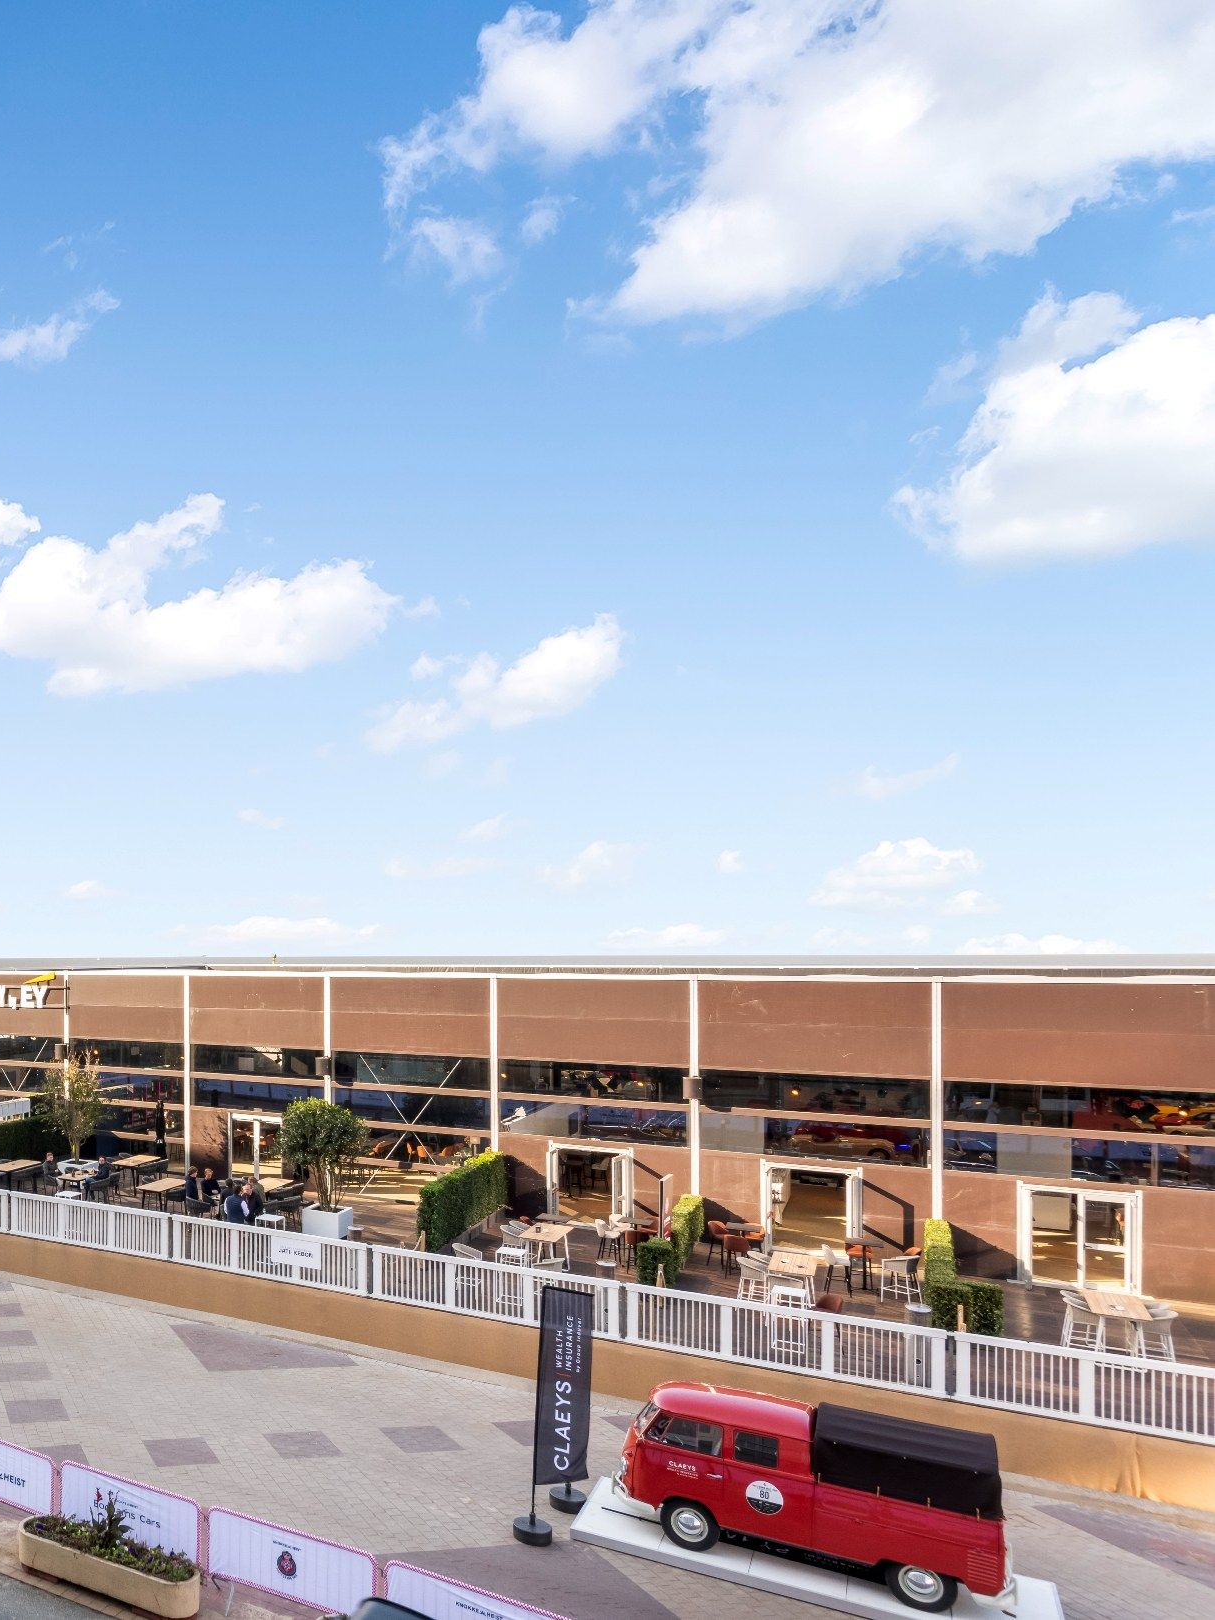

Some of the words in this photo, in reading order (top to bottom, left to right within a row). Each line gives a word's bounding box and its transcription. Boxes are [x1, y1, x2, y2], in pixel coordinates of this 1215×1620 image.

[21, 985, 48, 1009] EY
[555, 1330, 564, 1368] WEALTH
[565, 1315, 574, 1371] INSURANCE
[553, 1380, 572, 1471] CLAEYS
[668, 1460, 696, 1472] CLAEYS
[759, 1490, 770, 1500] 80
[139, 1514, 161, 1529] Cars
